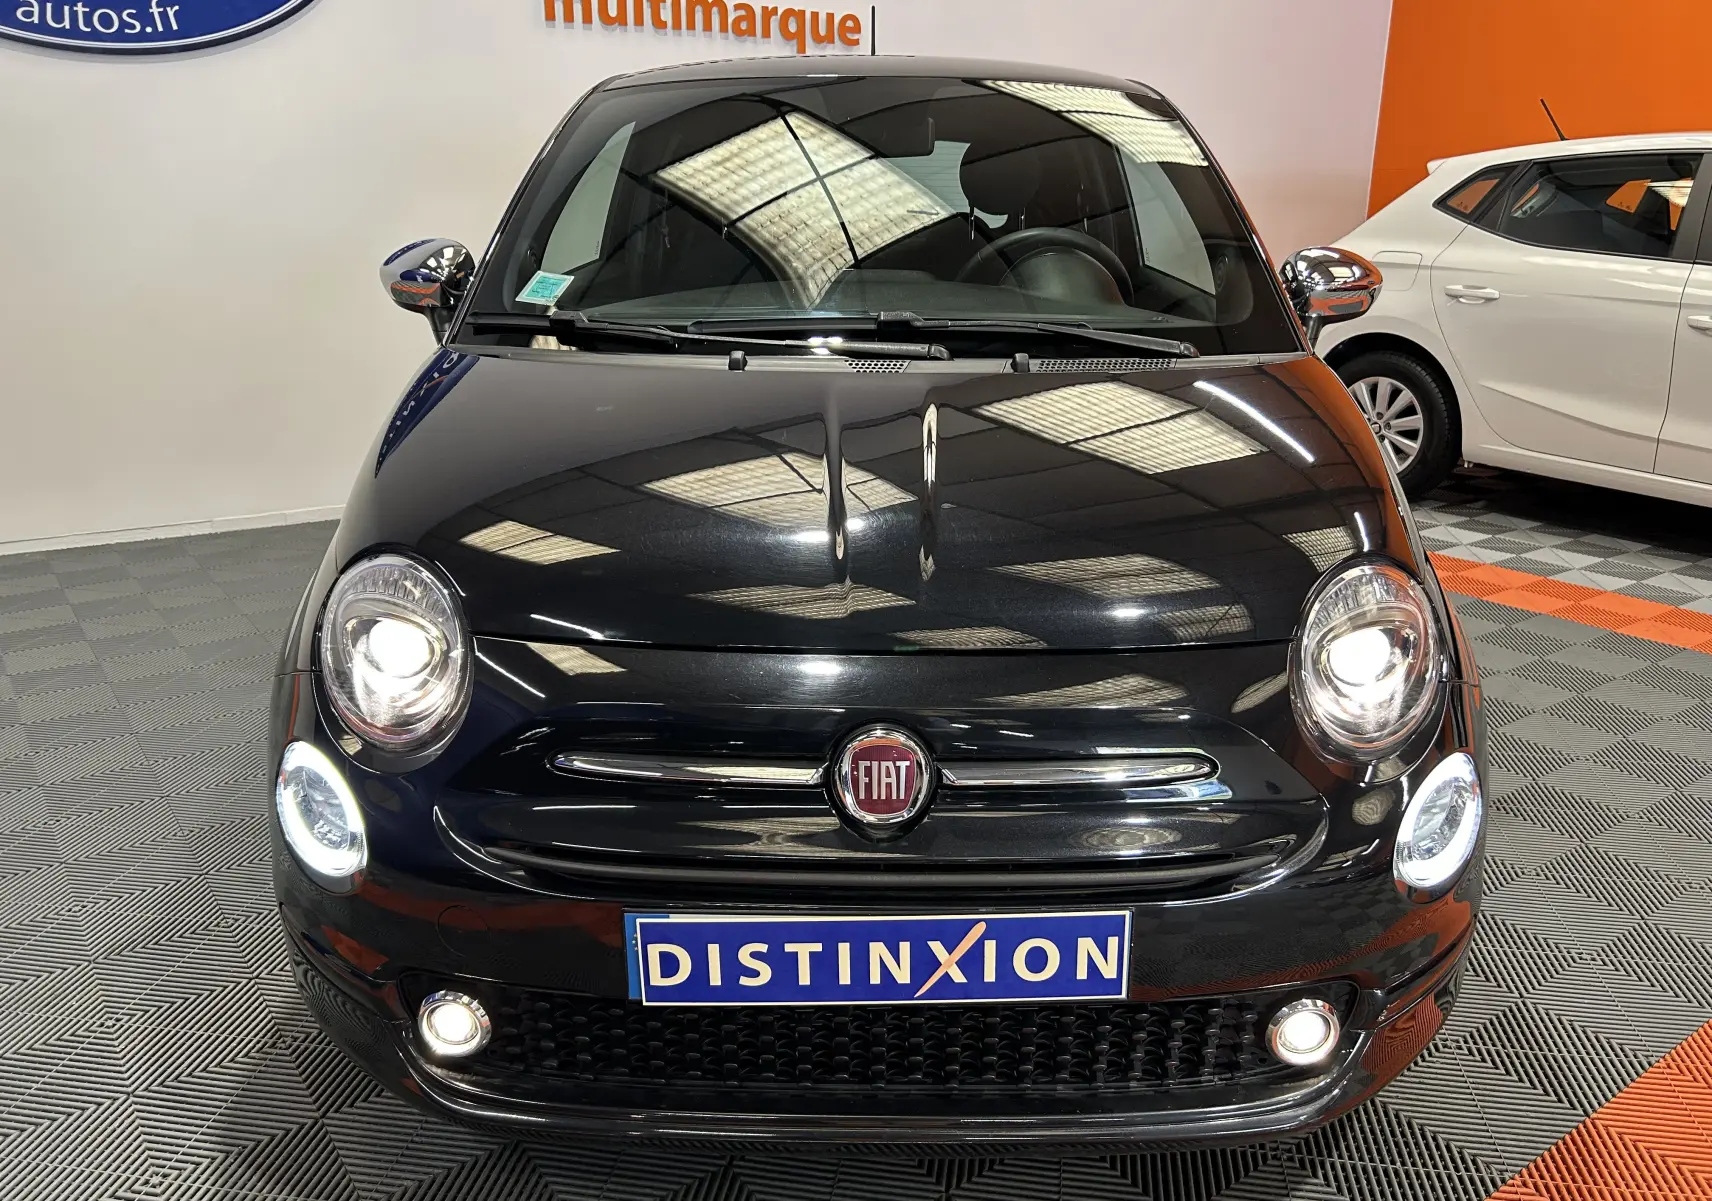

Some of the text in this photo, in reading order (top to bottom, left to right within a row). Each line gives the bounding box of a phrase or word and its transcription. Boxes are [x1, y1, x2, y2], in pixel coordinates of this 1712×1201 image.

[15, 0, 180, 34] autos.fr
[858, 760, 911, 800] FIAT
[646, 921, 1119, 997] DISTINXION
